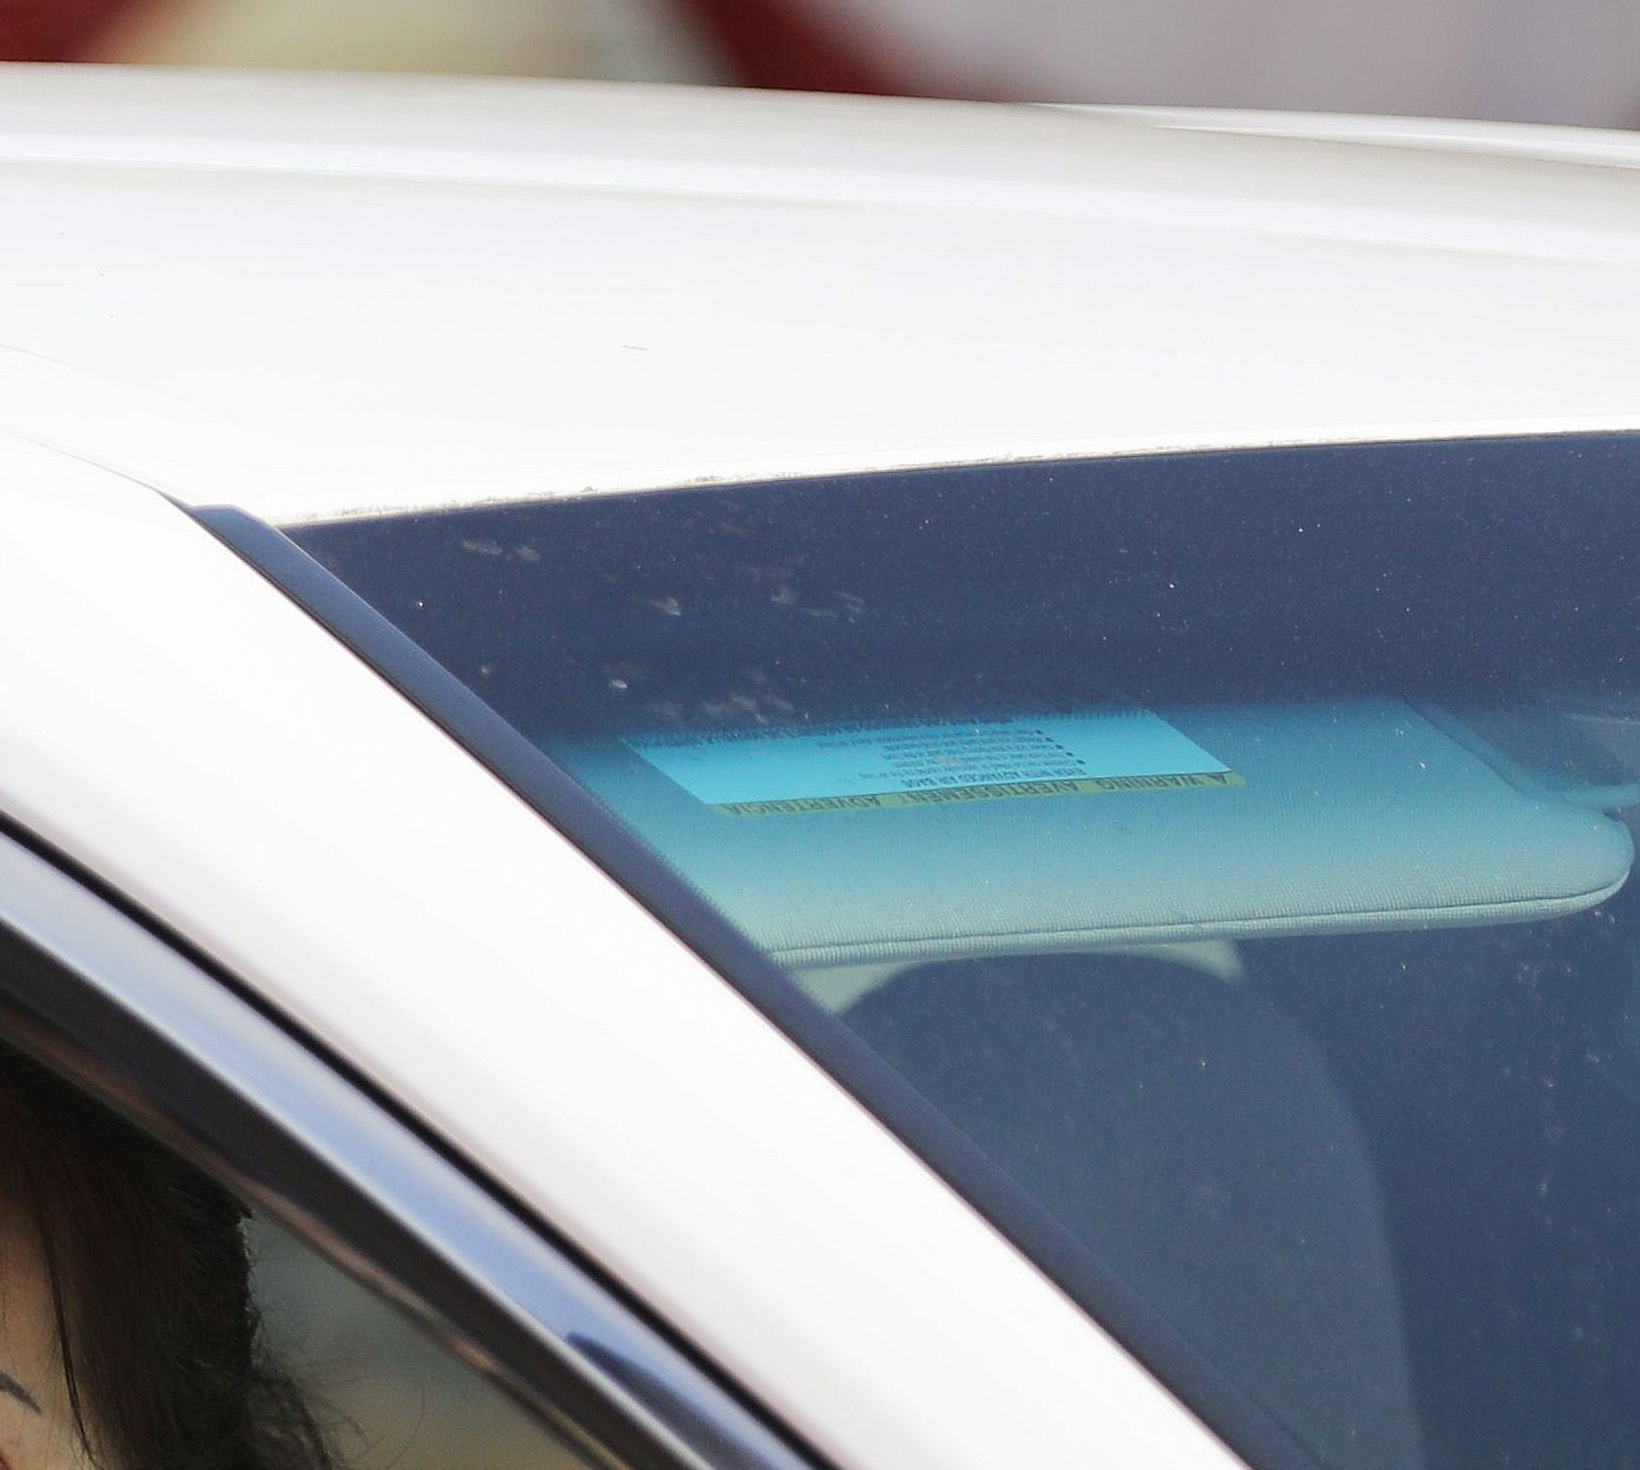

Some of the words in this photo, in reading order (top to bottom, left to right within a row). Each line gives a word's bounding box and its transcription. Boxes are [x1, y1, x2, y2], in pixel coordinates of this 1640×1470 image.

[900, 781, 1079, 803] AVERTISSEMENT
[1095, 774, 1201, 791] WARNING
[723, 795, 881, 815] ADVERTENCIA
